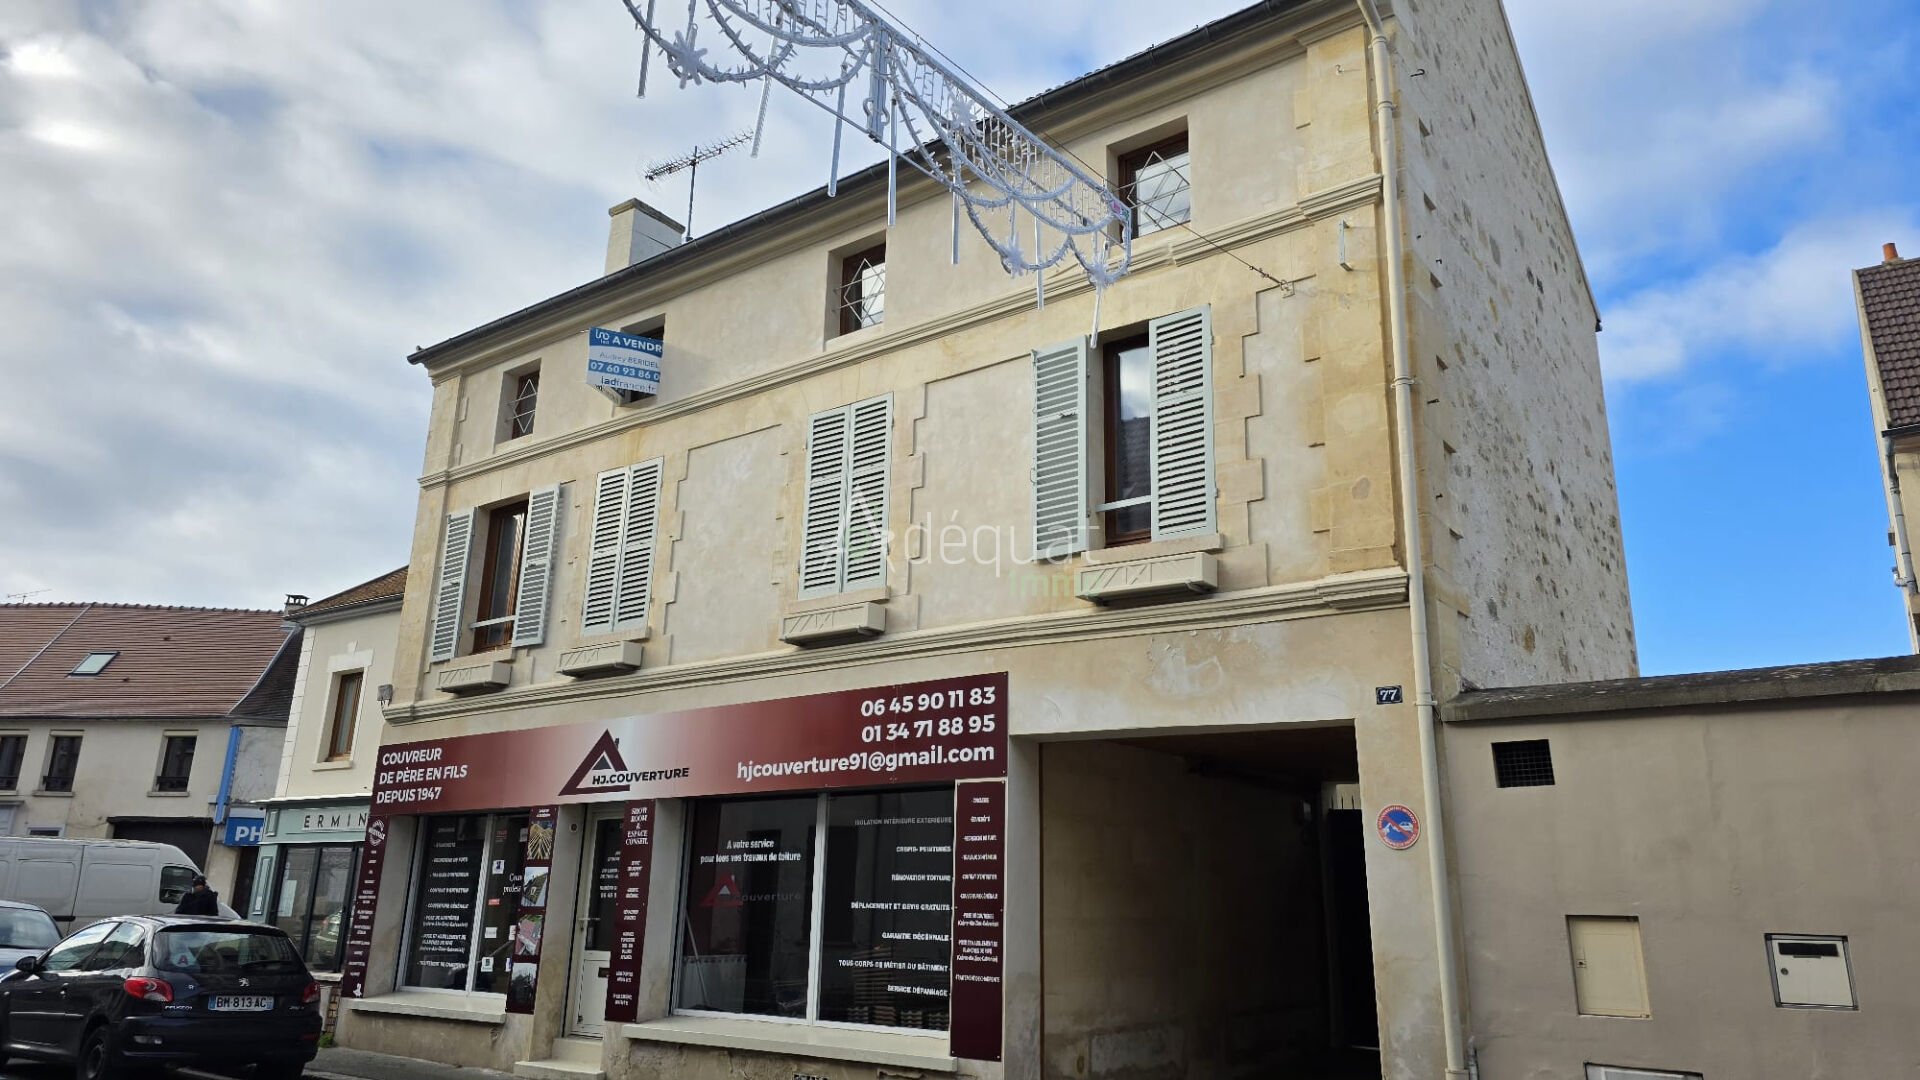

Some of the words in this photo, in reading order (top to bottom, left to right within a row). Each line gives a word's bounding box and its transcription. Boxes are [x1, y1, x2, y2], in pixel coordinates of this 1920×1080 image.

[612, 336, 621, 345] A
[590, 361, 604, 371] 07
[606, 364, 620, 374] 60
[622, 366, 636, 376] 93
[638, 369, 651, 379] 86
[860, 698, 886, 717] 06
[888, 695, 914, 714] 45
[917, 692, 945, 711] 90
[947, 689, 964, 709] 11
[968, 686, 996, 706] 83
[1380, 689, 1398, 701] 77
[861, 725, 881, 743] 01
[886, 722, 909, 741] 34
[913, 719, 933, 738] 71
[937, 716, 964, 736] 88
[968, 713, 996, 733] 95
[382, 747, 442, 766] COUVREUR
[737, 745, 995, 781] hjcouverture91@gmail.com
[379, 771, 395, 785] DE
[395, 766, 425, 783] PÈRE
[425, 767, 442, 781] EN
[443, 764, 469, 780] FILS
[591, 767, 690, 785] HJ.COUVERTURE
[376, 788, 416, 804] DEPUIS
[417, 786, 442, 802] 1947
[625, 837, 649, 846] CONSEIL
[627, 830, 648, 838] ESPACE
[733, 839, 749, 849] votre
[750, 838, 775, 848] service
[700, 855, 715, 864] pour
[715, 853, 729, 863] tous
[730, 853, 742, 862] vos
[743, 852, 768, 863] travaux
[768, 851, 778, 861] de
[778, 851, 802, 861] toiture
[838, 959, 854, 968] TOUS
